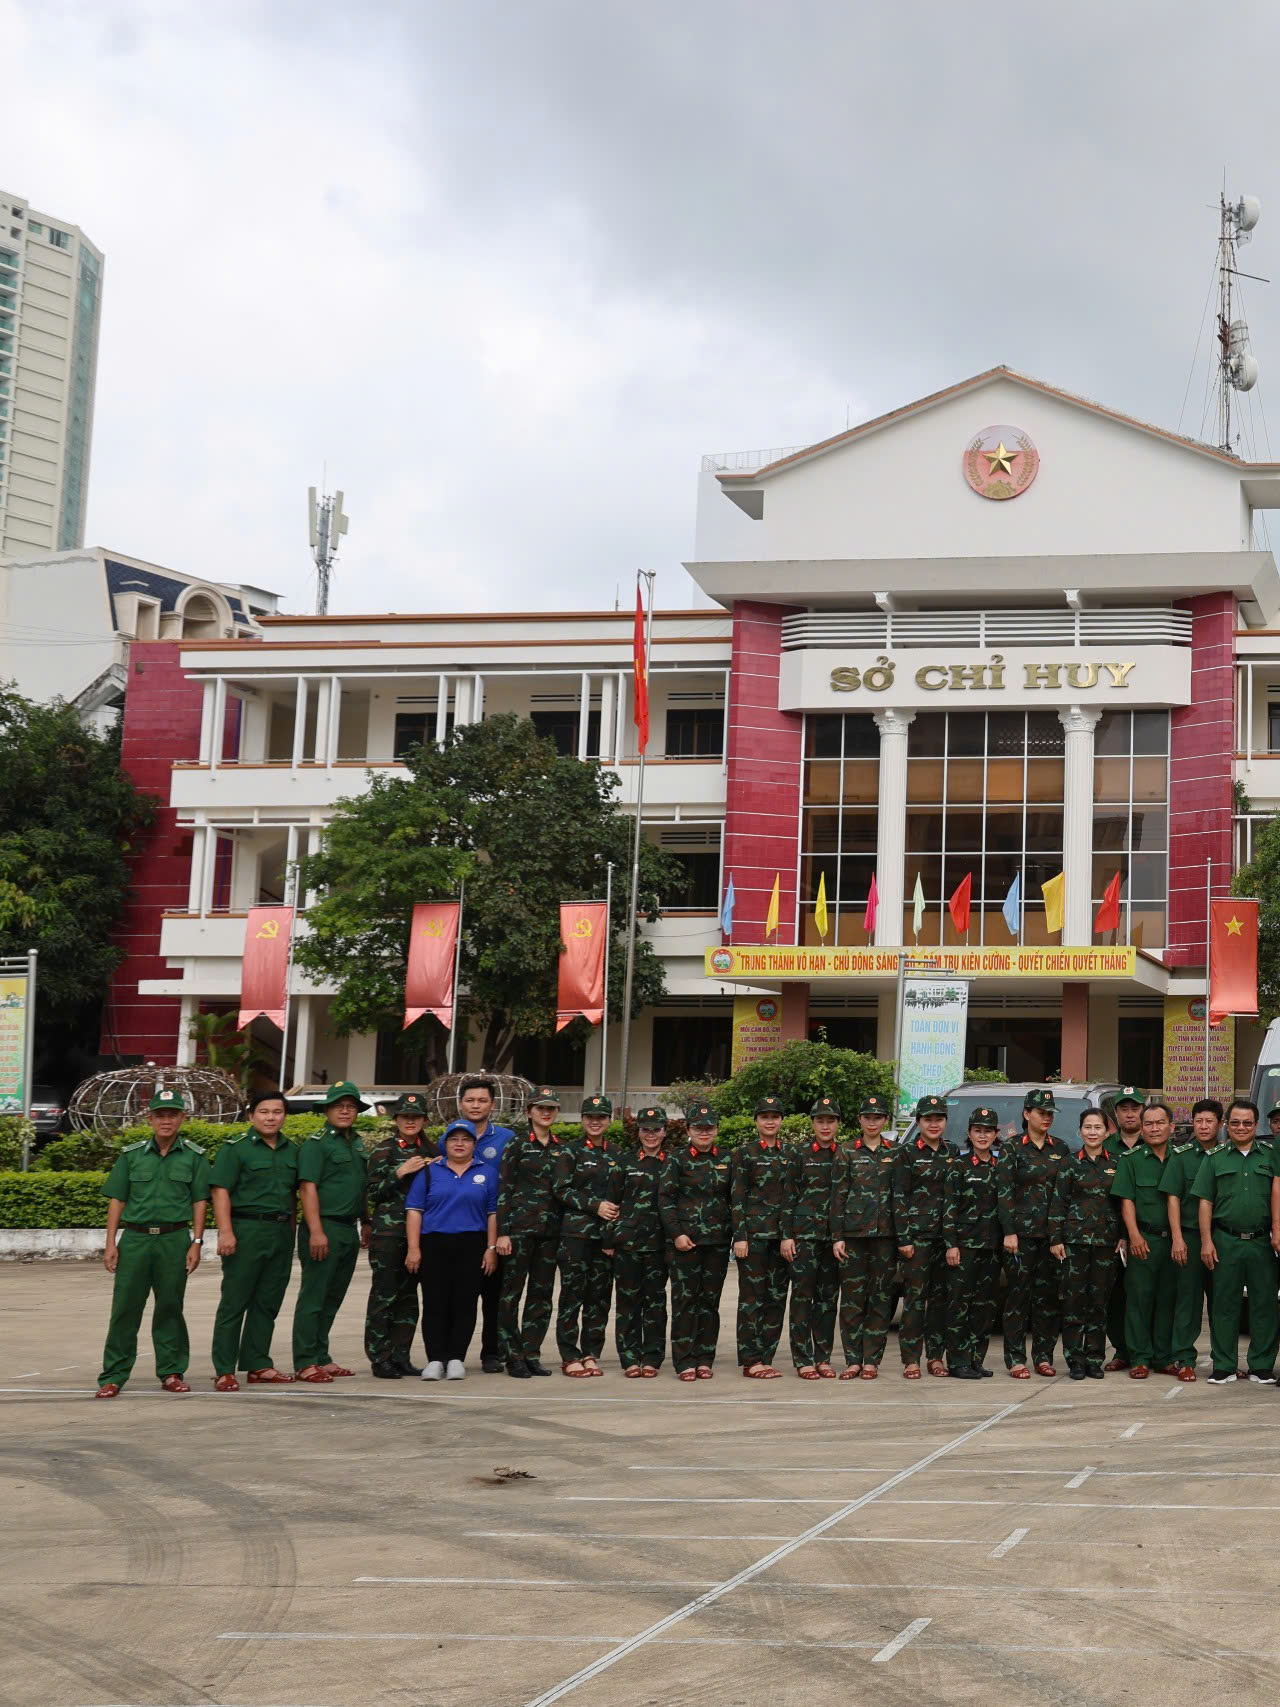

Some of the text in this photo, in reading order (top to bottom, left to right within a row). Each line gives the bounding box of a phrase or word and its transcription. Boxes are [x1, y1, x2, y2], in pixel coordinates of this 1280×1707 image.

[830, 654, 1136, 692] SỞ CHỈ HUY
[768, 953, 795, 970] THÀNH
[797, 951, 807, 970] VÔ
[809, 955, 826, 974] HẠN
[833, 950, 849, 970] CHỦ
[851, 951, 874, 974] ĐỘNG
[876, 951, 897, 970] SÁNG
[962, 952, 981, 970] KIÊN
[983, 951, 1011, 970] CƯỜNG
[1018, 950, 1044, 970] QUYẾT
[1045, 950, 1070, 970] CHIẾN
[1072, 950, 1098, 970] QUYẾT
